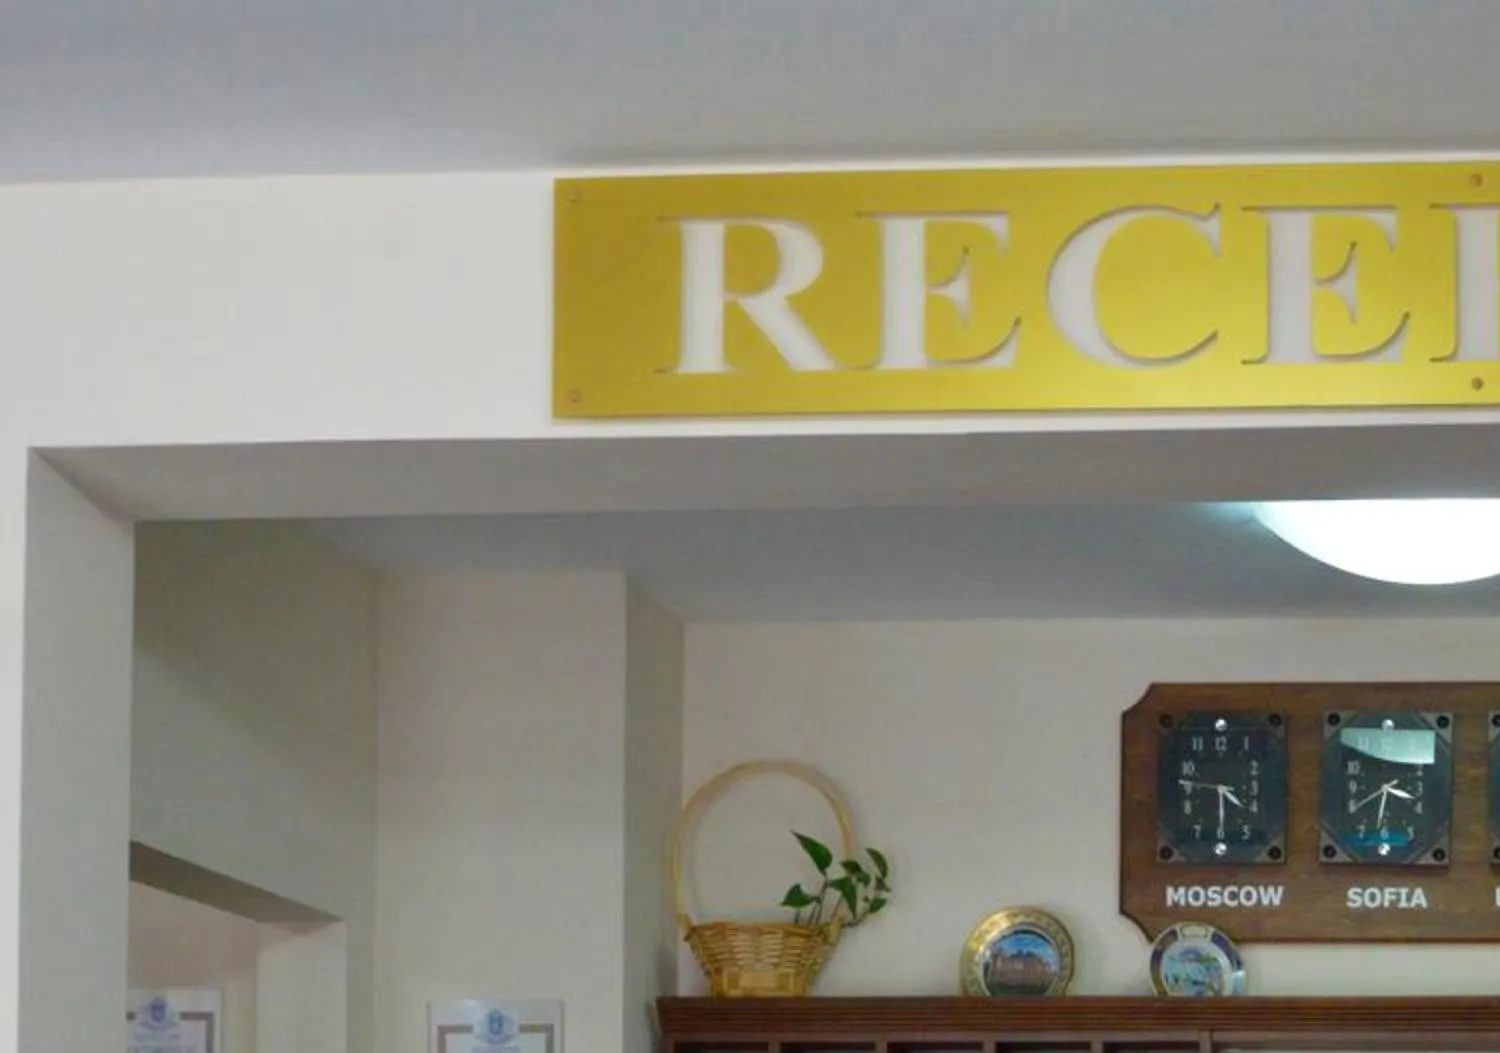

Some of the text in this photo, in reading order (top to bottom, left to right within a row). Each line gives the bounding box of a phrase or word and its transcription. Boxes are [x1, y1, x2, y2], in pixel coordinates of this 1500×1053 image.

[1215, 736, 1227, 751] 12
[1182, 761, 1195, 775] 10
[1347, 761, 1360, 775] 10
[1166, 885, 1284, 908] MOSCOW
[1346, 886, 1428, 909] SOFIA
